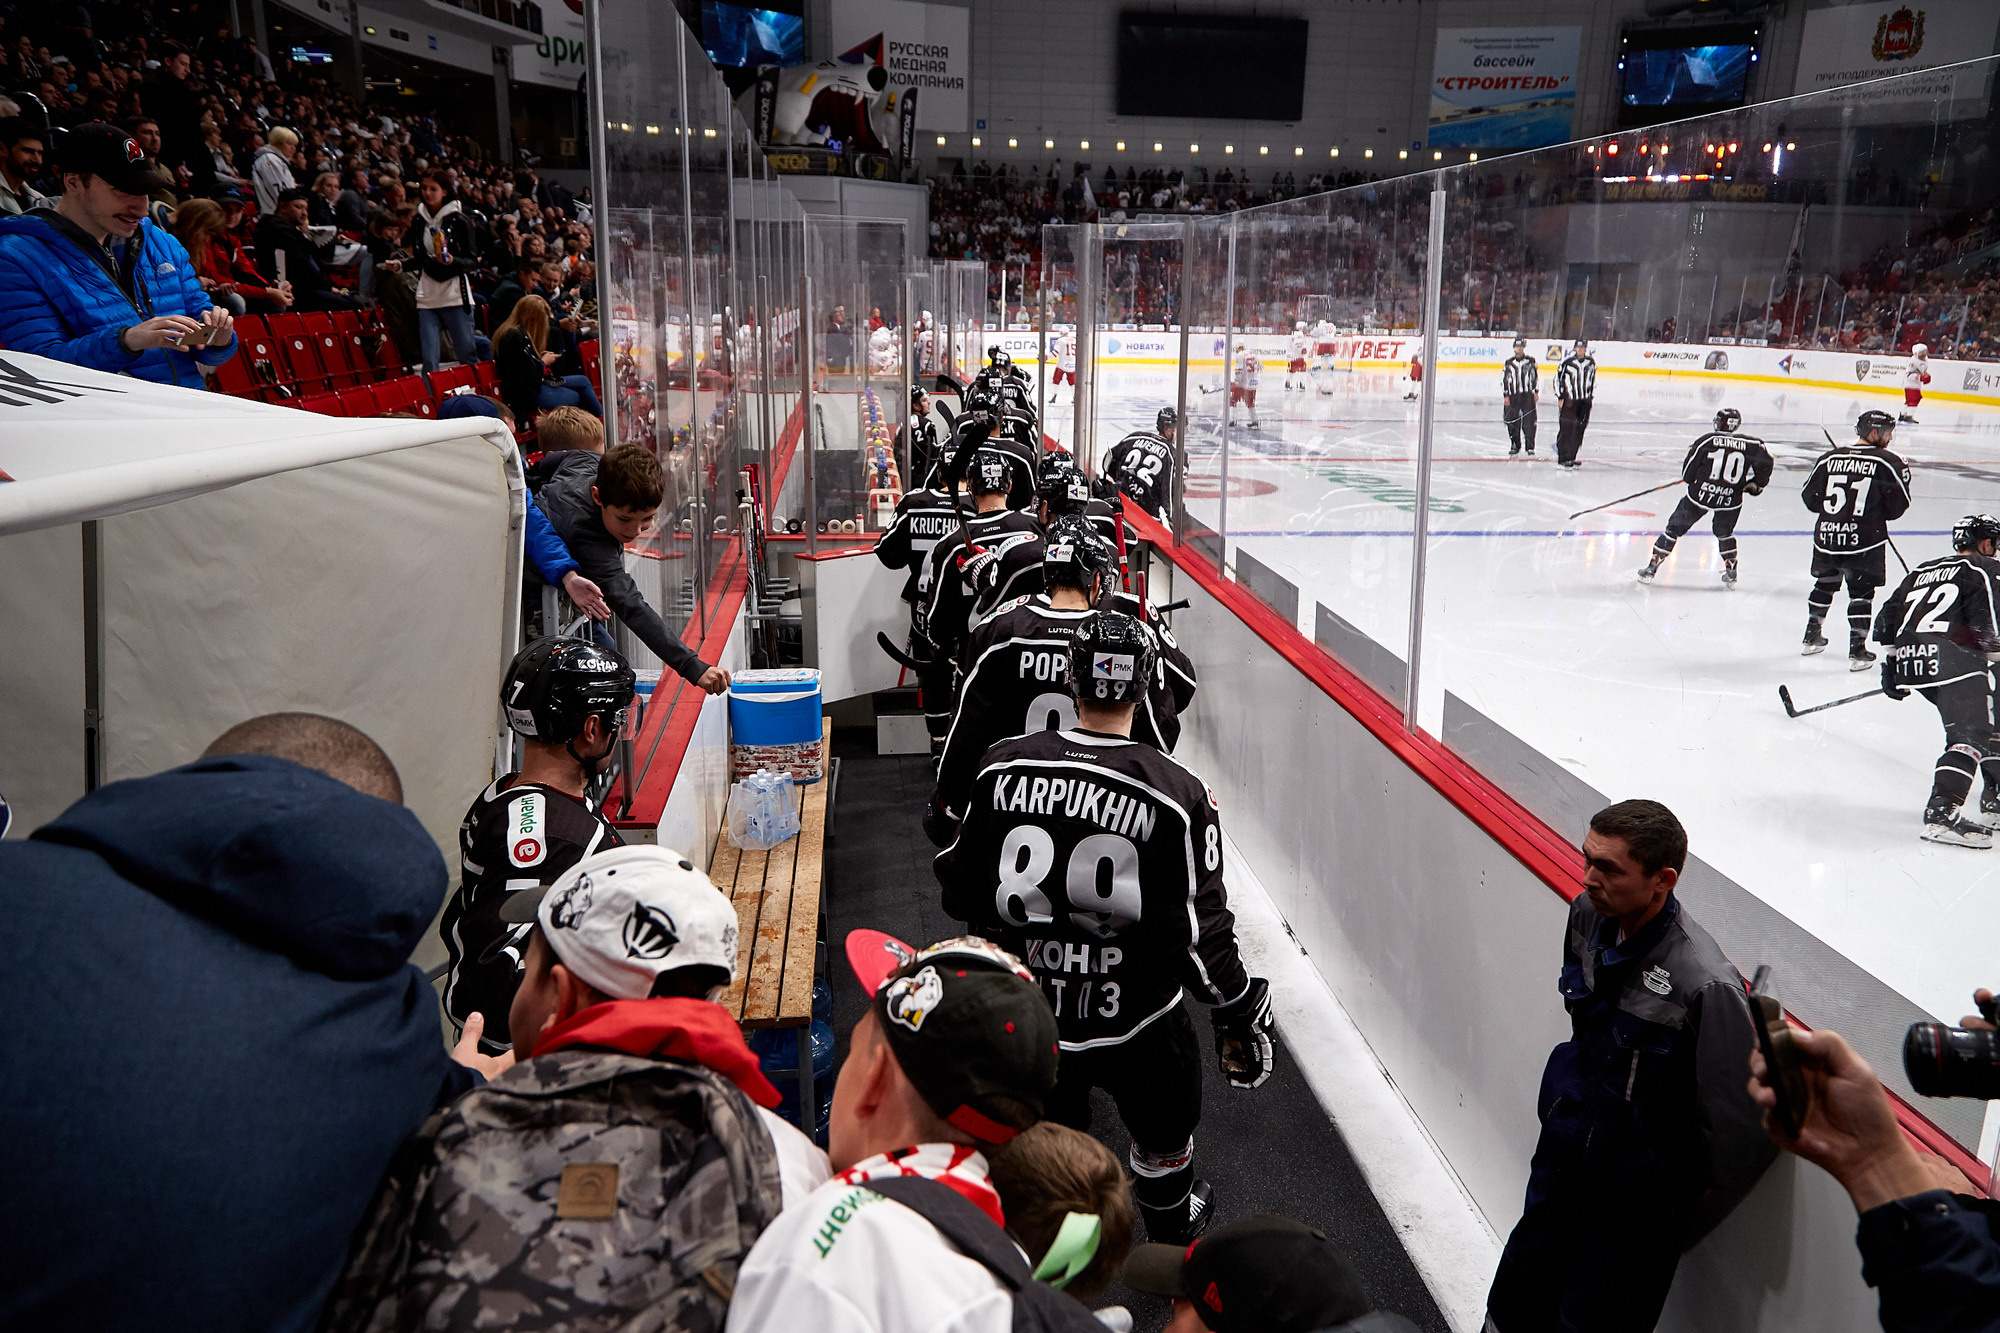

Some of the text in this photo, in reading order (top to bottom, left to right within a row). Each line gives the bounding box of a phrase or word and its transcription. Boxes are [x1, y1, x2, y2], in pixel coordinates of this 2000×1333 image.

[889, 41, 948, 59] РУССКАЯ
[889, 56, 947, 73] МЕДНАЯ
[1473, 54, 1536, 68] бассейн
[889, 72, 964, 90] КОМПАНИЯ
[1815, 72, 1836, 82] ПРИ
[1837, 67, 1900, 80] ПОДДЕРЖКЕ
[1005, 340, 1038, 350] СОГА
[1126, 342, 1165, 351] НОВАТЭК
[1003, 387, 1018, 398] HOV
[1712, 436, 1747, 452] GLINKIN
[1121, 449, 1163, 487] 22
[1707, 448, 1746, 484] 10
[1826, 458, 1878, 476] VIRTANEN
[985, 477, 1000, 489] 24
[1700, 481, 1734, 496] КОНАР
[1822, 474, 1872, 517] 51
[1820, 521, 1858, 532] КОНАР
[1820, 532, 1860, 546] ЧТПЗ
[1913, 565, 1962, 588] KONKOV
[1896, 583, 1960, 638] 72
[1048, 627, 1075, 635] LUTCH
[577, 658, 619, 672] КОНАР
[1019, 651, 1068, 682] POP
[1113, 663, 1133, 672] РМК
[510, 681, 525, 705] 7
[1095, 680, 1127, 700] 89
[515, 718, 535, 728] РМК
[1064, 750, 1098, 760] LUTCH
[993, 774, 1157, 842] KARPUKHIN
[1205, 823, 1220, 871] 8
[995, 824, 1143, 938] 89
